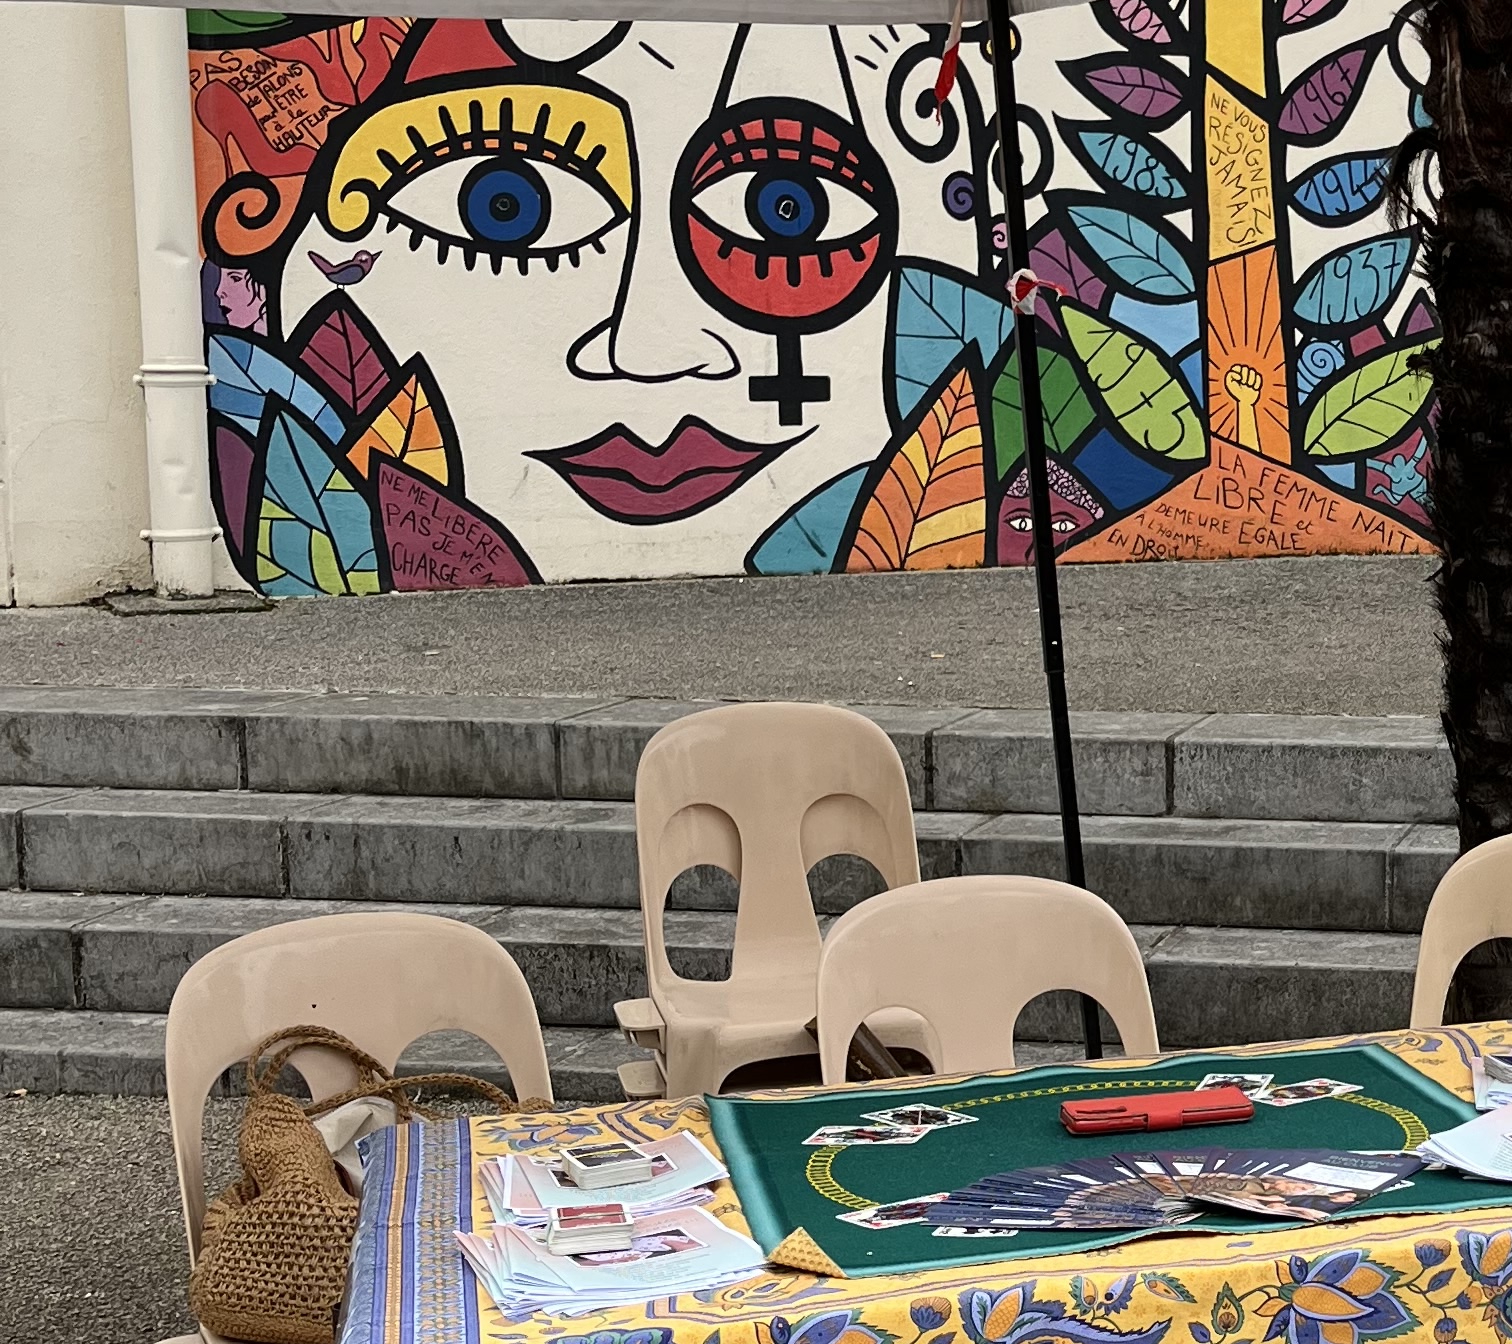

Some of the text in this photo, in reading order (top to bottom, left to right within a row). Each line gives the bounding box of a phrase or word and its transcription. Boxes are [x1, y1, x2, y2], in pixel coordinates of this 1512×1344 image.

[190, 51, 242, 91] PAS
[247, 94, 262, 108] de
[273, 83, 309, 110] ÊTRE
[1210, 93, 1266, 143] NE VOUS
[1290, 58, 1354, 134] 1967
[273, 105, 344, 151] HAUTEUR
[274, 109, 307, 132] à la
[1098, 133, 1174, 199] 1983
[1309, 243, 1401, 324] 1937
[1085, 330, 1190, 454] 1975
[381, 470, 406, 491] NE
[407, 484, 429, 507] ME
[1218, 446, 1246, 479] LA
[1259, 467, 1341, 522] FEMME
[386, 503, 430, 536] PAS
[432, 532, 455, 555] JE
[1108, 529, 1129, 547] EN
[1155, 502, 1231, 535] DEMEURE
[392, 542, 461, 585] CHARGE
